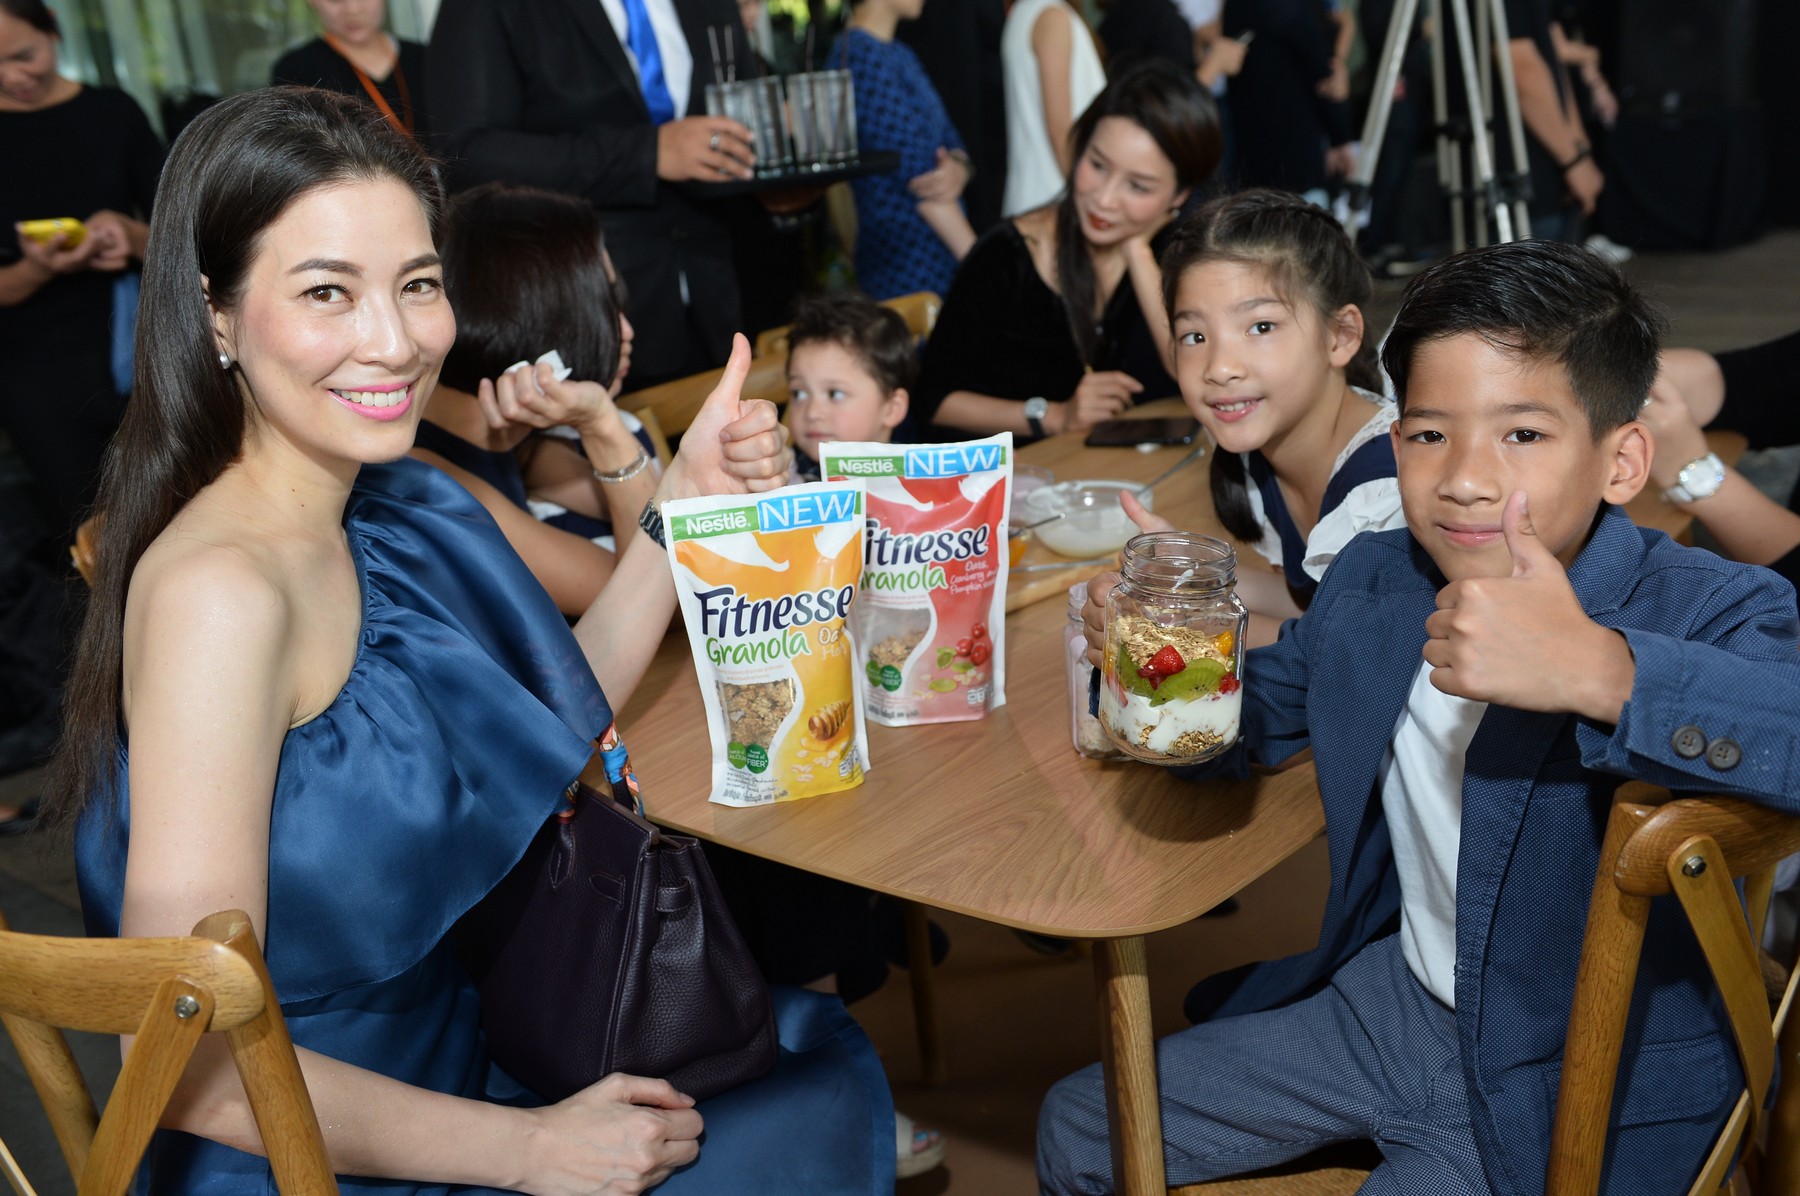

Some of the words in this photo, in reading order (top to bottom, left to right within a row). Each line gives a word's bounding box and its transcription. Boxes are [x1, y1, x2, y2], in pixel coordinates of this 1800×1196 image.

[908, 446, 998, 476] NEW
[760, 492, 854, 529] NEW
[865, 520, 988, 566] itnesse
[861, 564, 947, 593] ranola
[693, 585, 854, 638] Fitnesse
[706, 629, 810, 666] Granola
